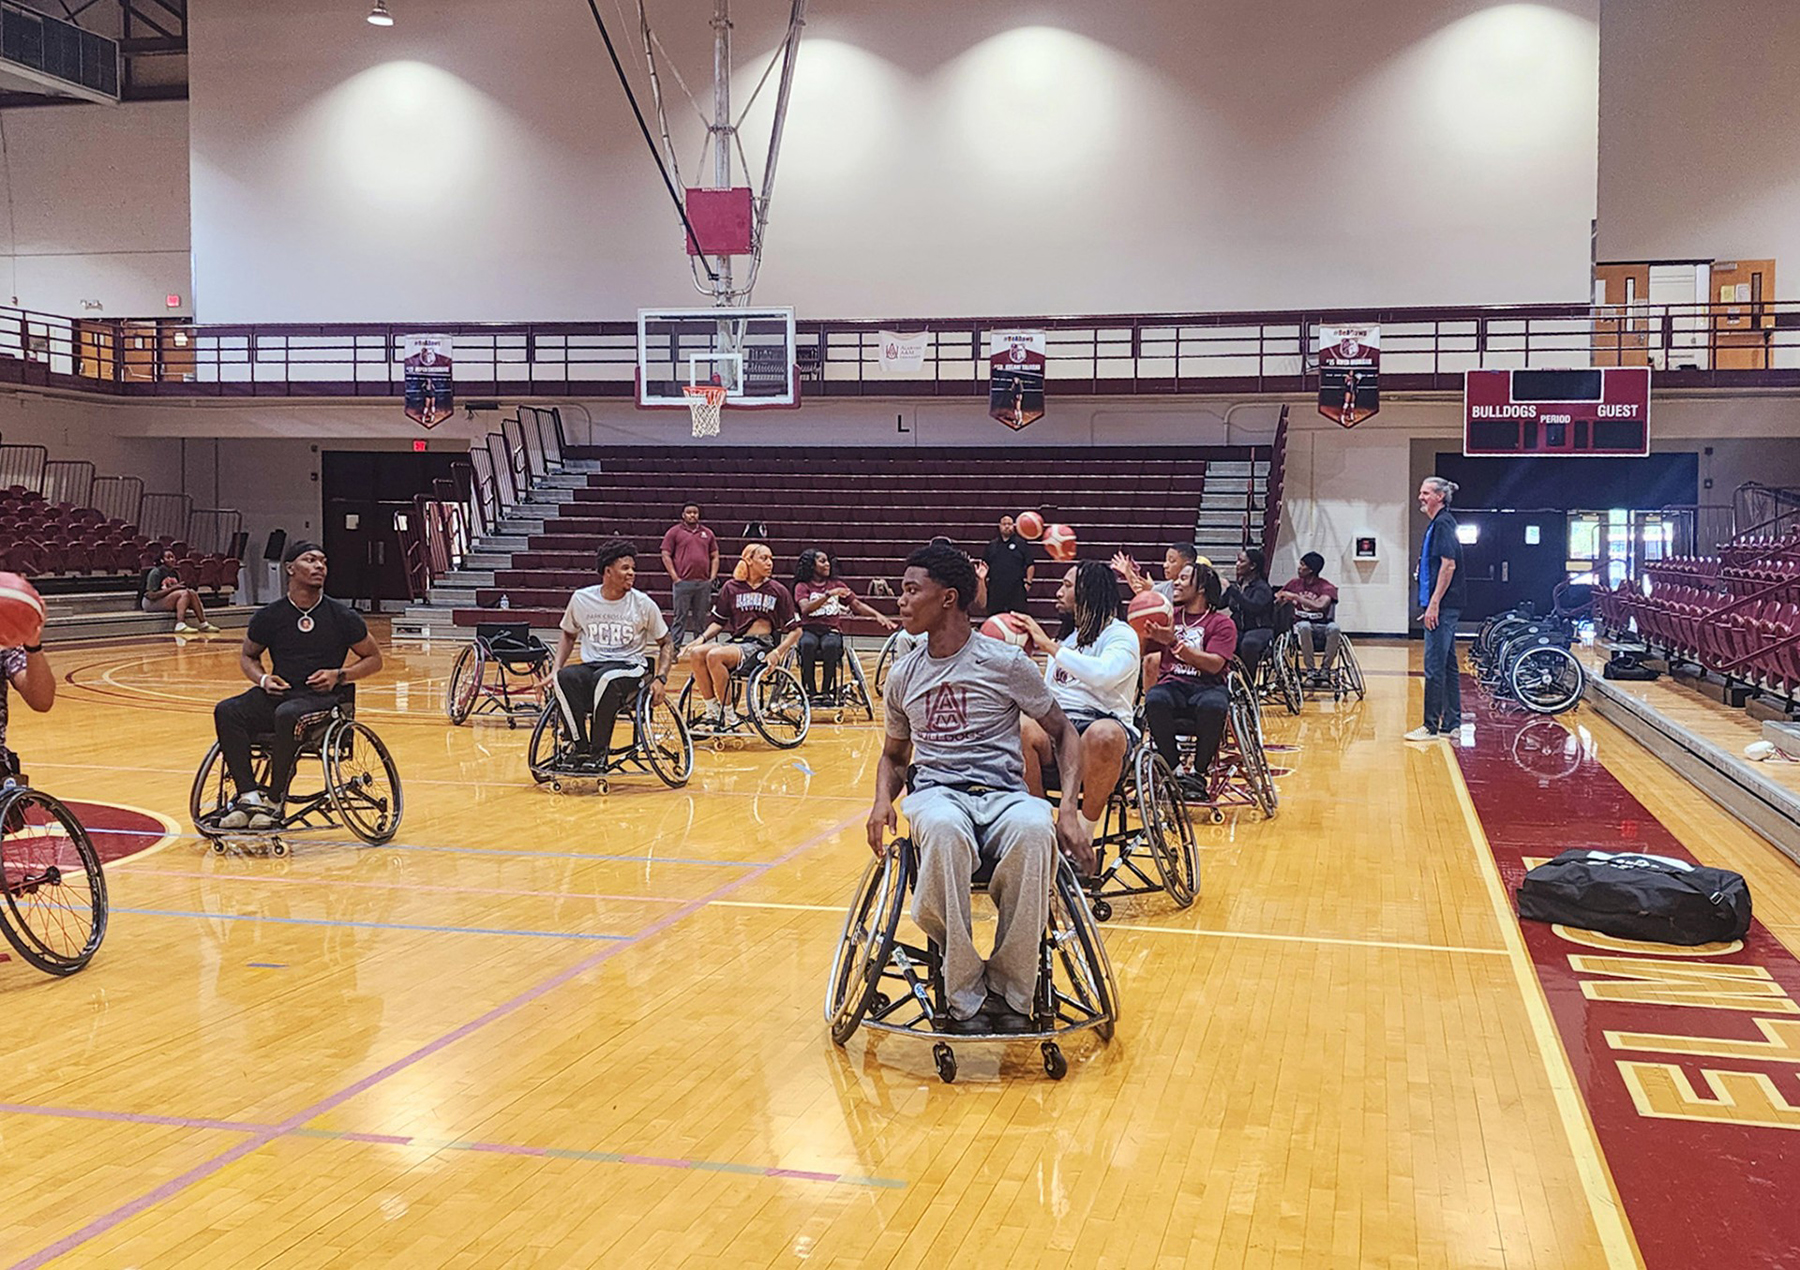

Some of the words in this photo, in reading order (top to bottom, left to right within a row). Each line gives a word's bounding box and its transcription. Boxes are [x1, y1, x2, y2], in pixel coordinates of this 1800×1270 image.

[1472, 405, 1537, 418] BULLDOGS
[1597, 404, 1639, 418] GUEST
[897, 415, 910, 433] L
[1540, 414, 1571, 424] PERIOD
